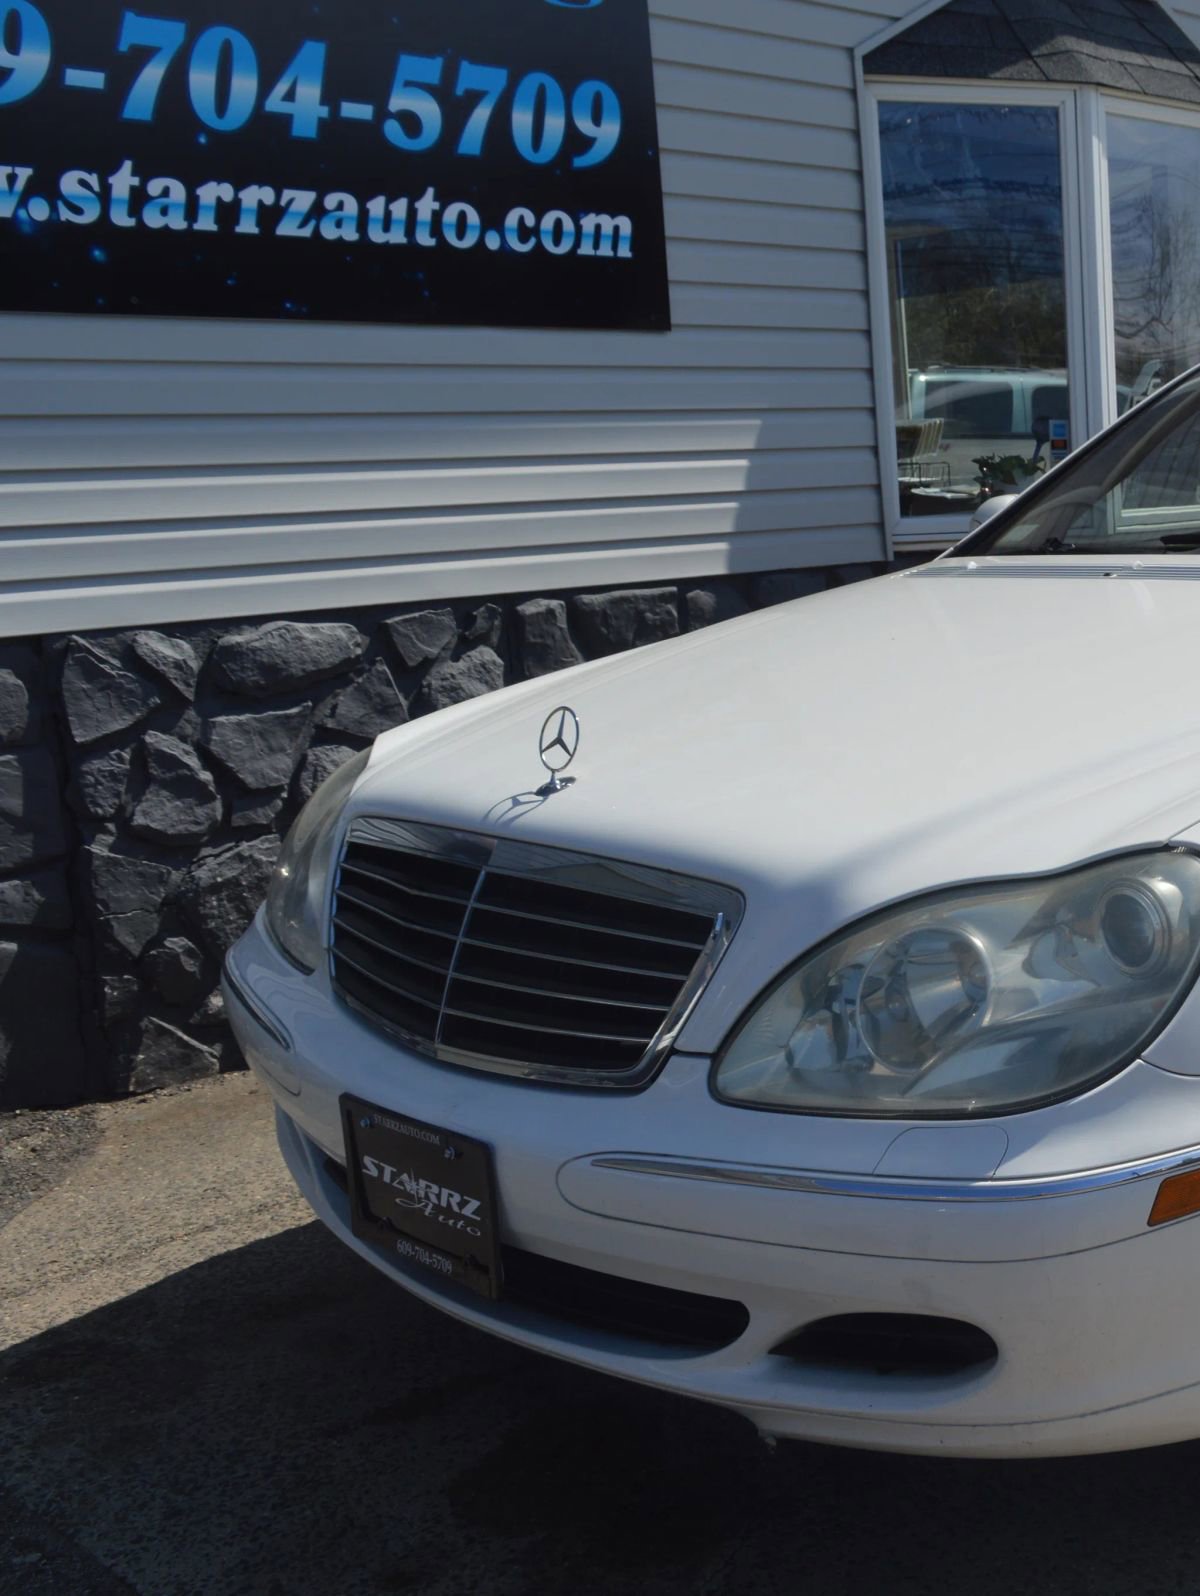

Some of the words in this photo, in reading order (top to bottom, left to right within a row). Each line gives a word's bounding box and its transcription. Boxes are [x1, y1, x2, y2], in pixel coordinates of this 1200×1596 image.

[362, 1155, 481, 1221] STARRZ
[395, 1198, 481, 1237] Auto
[396, 1239, 453, 1274] 609-704-5709
